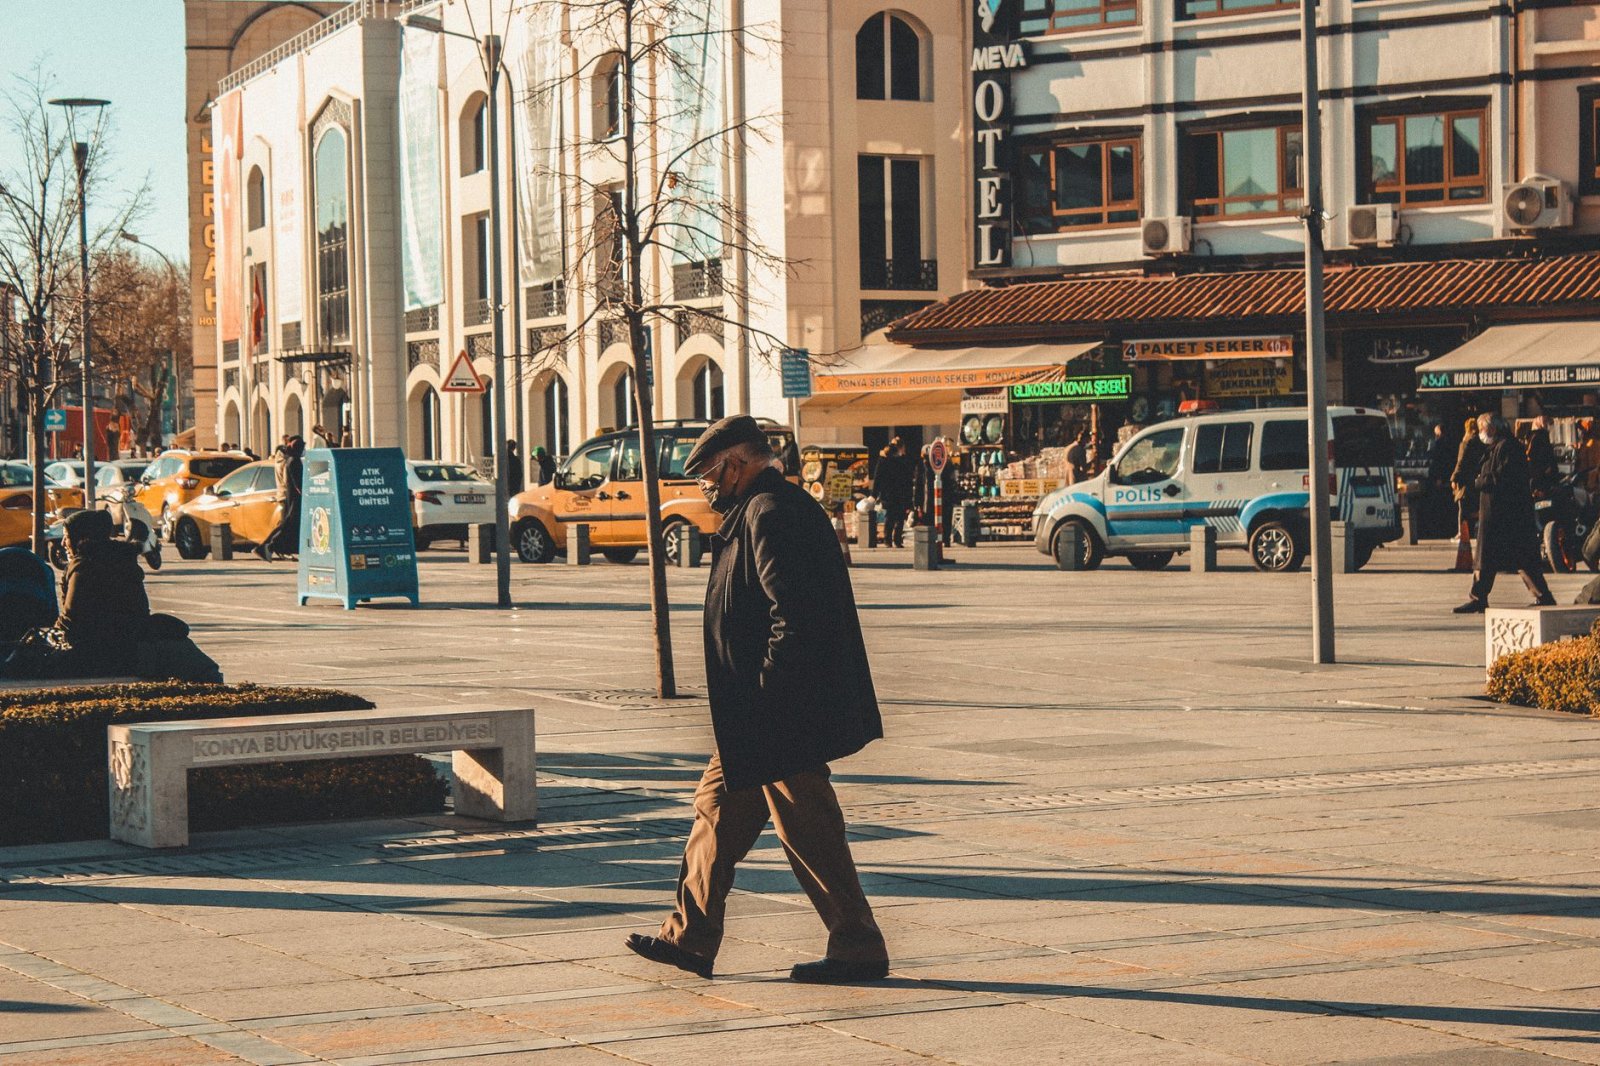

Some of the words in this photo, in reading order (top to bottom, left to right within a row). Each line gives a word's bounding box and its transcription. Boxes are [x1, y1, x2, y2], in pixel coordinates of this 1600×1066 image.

[971, 43, 1026, 72] MEVA
[975, 80, 1004, 265] OTEL
[1124, 342, 1137, 359] 4
[1141, 342, 1197, 355] PAKET
[838, 378, 867, 388] KONYA
[909, 375, 942, 385] HURMA
[985, 372, 1016, 382] KONYA
[1454, 372, 1478, 386] KONYA
[1479, 369, 1504, 387] ŞEKERİ
[1513, 369, 1539, 384] HURMA
[1541, 366, 1568, 384] ŞEKERİ
[1062, 380, 1093, 396] KONYA
[1094, 376, 1127, 398] ŞEKERİ
[362, 468, 380, 476] ATIK
[360, 477, 385, 486] GEÇİCİ
[352, 488, 394, 496] DEPOLAMA
[1115, 487, 1162, 502] POLİS
[359, 496, 390, 506] ÜNİTESİ
[194, 738, 260, 758] KONYA
[264, 730, 385, 752] BÜYÜKŞEHİR
[390, 719, 495, 745] BELEDİYESİ
